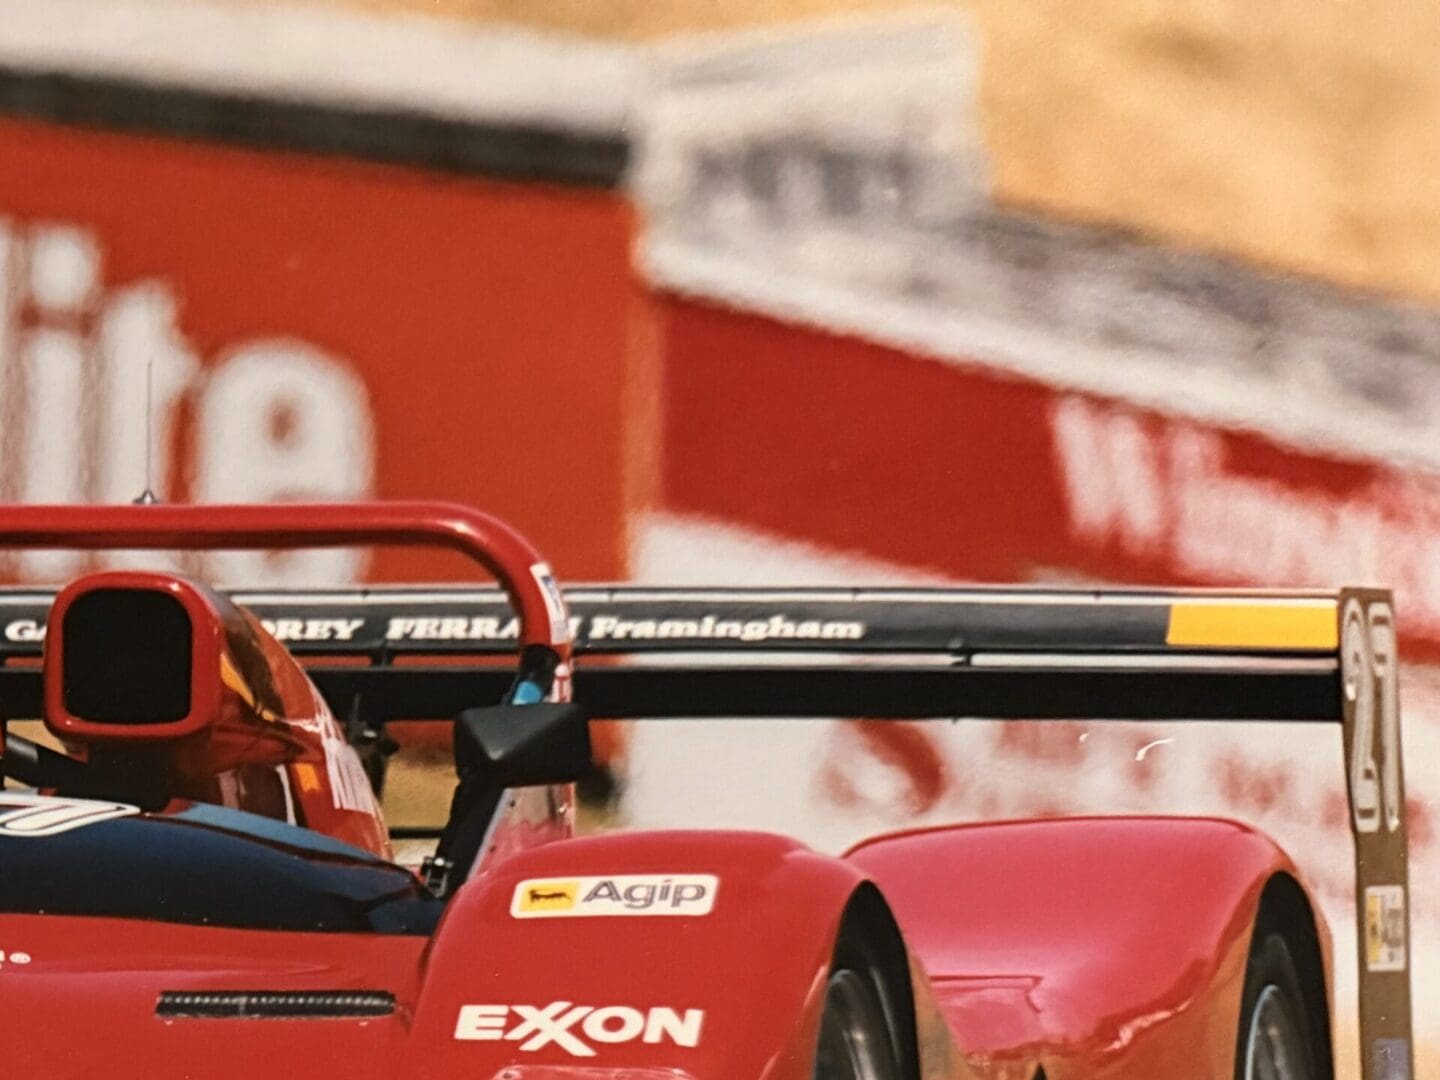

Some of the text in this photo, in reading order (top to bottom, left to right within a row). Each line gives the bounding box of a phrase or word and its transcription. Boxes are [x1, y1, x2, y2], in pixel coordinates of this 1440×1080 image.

[588, 614, 865, 641] Framingham
[582, 879, 707, 909] Agip
[454, 1001, 704, 1056] EXXON
